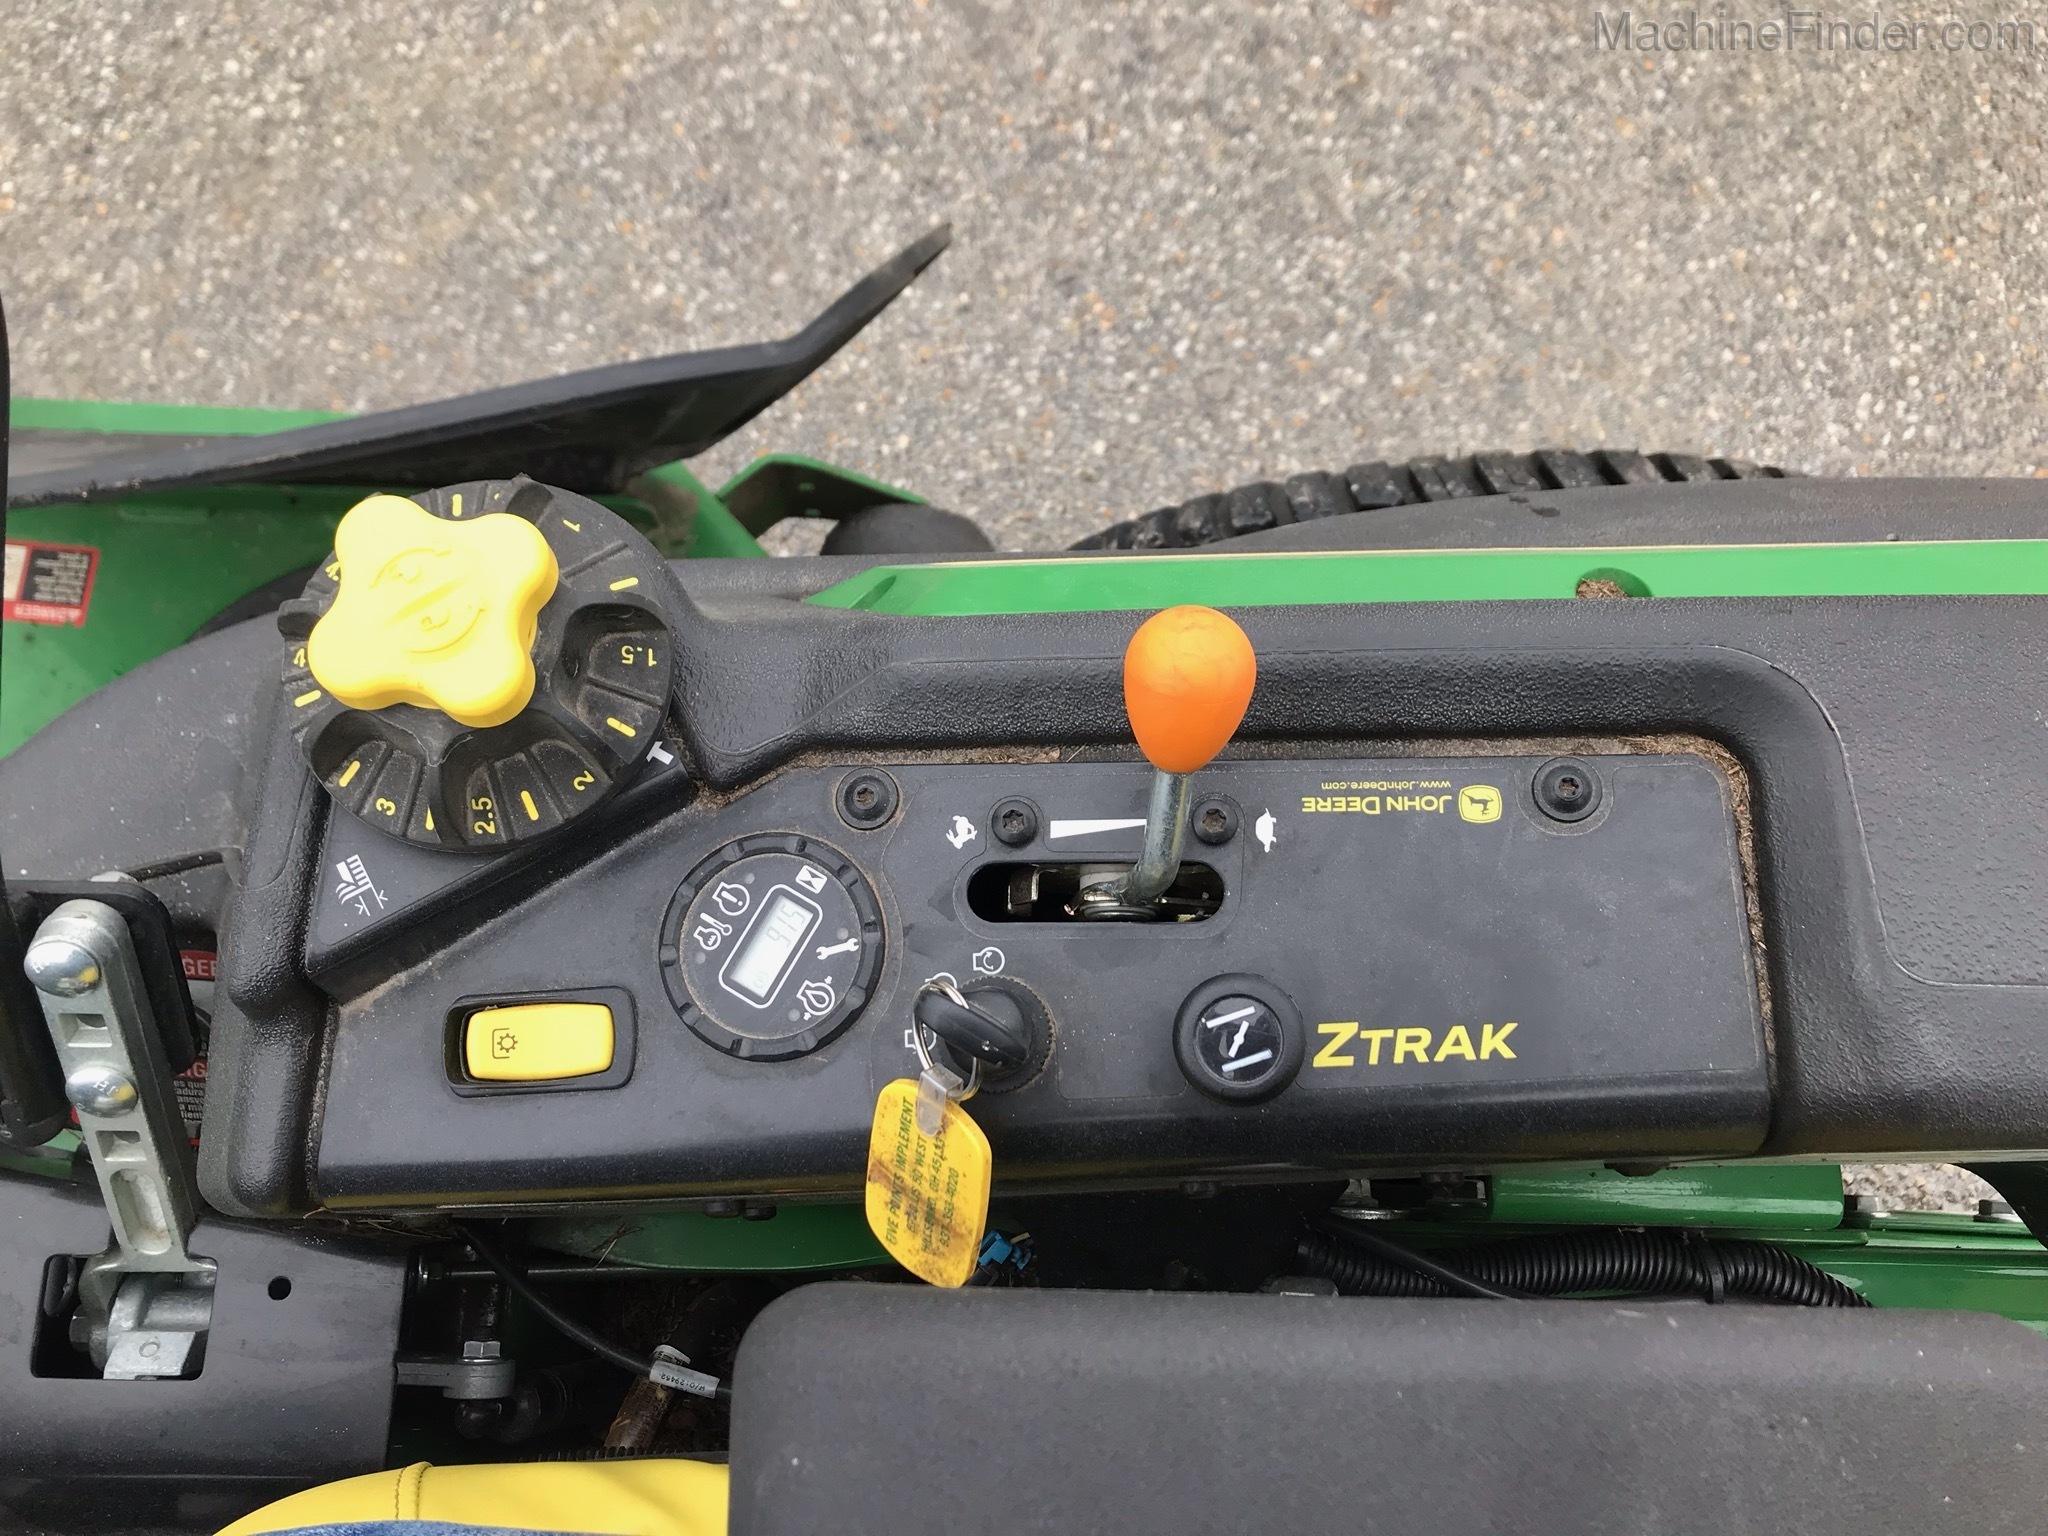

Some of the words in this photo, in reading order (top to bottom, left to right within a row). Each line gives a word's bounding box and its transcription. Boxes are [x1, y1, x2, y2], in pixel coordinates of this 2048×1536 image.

[621, 645, 657, 667] 1.5
[573, 770, 594, 791] 2
[1321, 780, 1451, 791] www.JohnDeere.com
[376, 798, 396, 816] 3
[1302, 796, 1381, 814] DEERE
[1386, 795, 1452, 814] JOHN
[471, 797, 496, 835] 2.5
[895, 1096, 914, 1172] IMPLEMENT
[915, 1134, 928, 1168] WEST
[889, 1173, 905, 1217] POINTS
